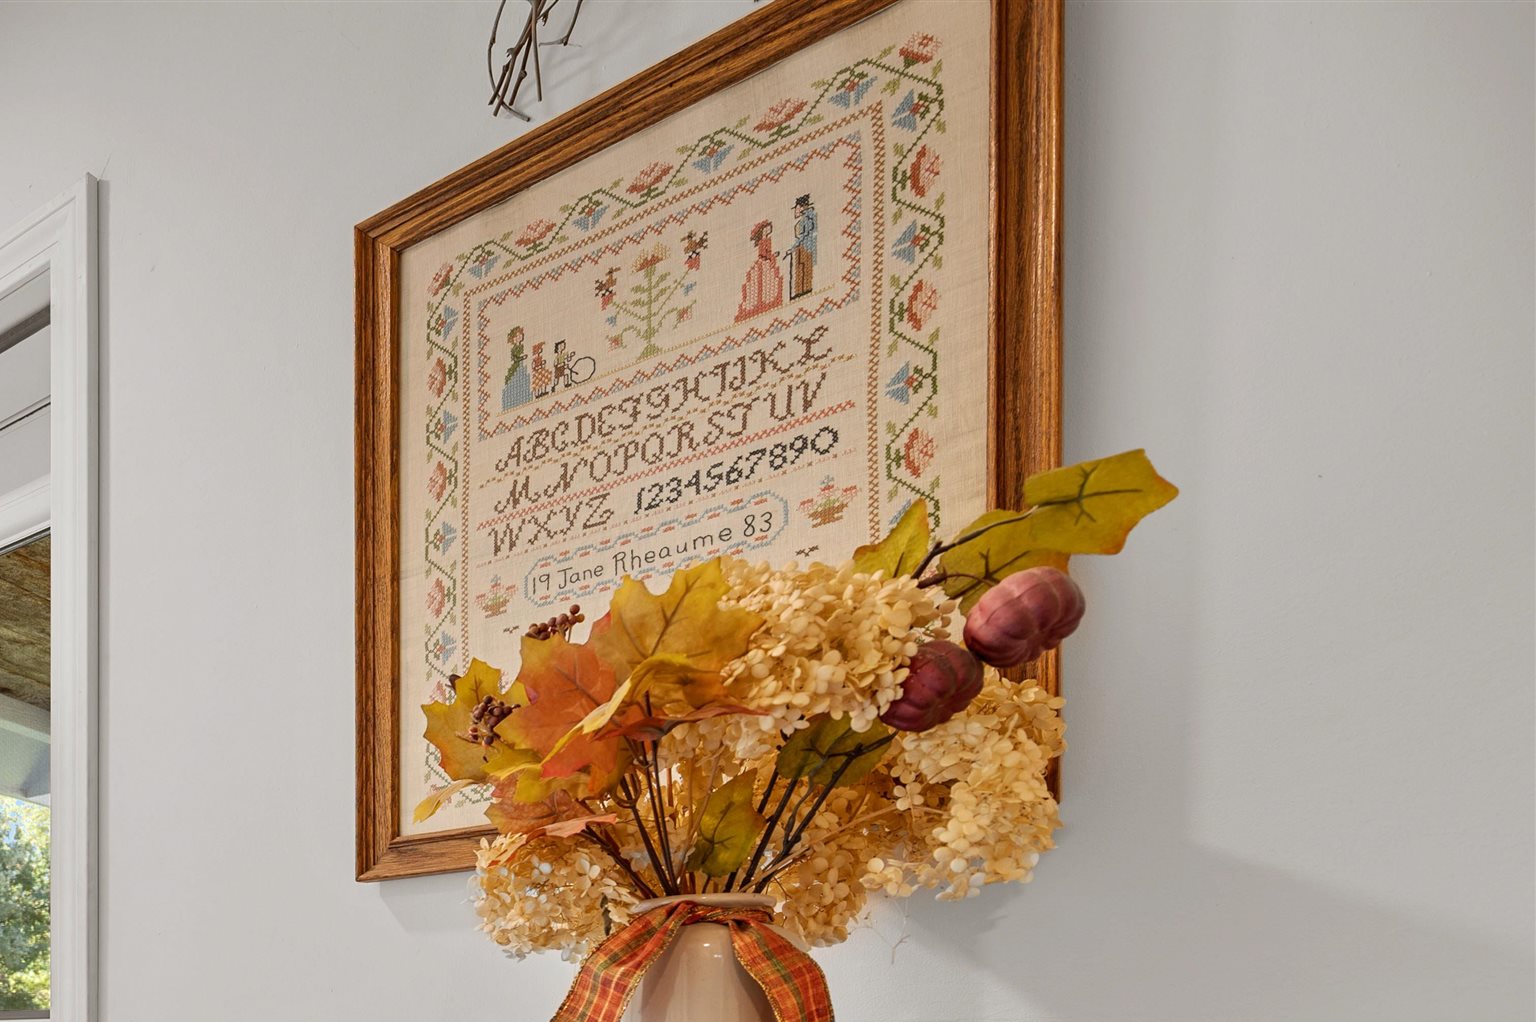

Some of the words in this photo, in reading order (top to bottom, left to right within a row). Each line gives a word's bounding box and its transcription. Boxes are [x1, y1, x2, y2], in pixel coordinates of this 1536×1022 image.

[487, 492, 615, 557] WXYZ
[633, 425, 840, 515] 1234567890
[532, 573, 551, 595] 19
[557, 564, 605, 590] Jane
[612, 527, 733, 577] Rheaume
[742, 510, 774, 538] 83
